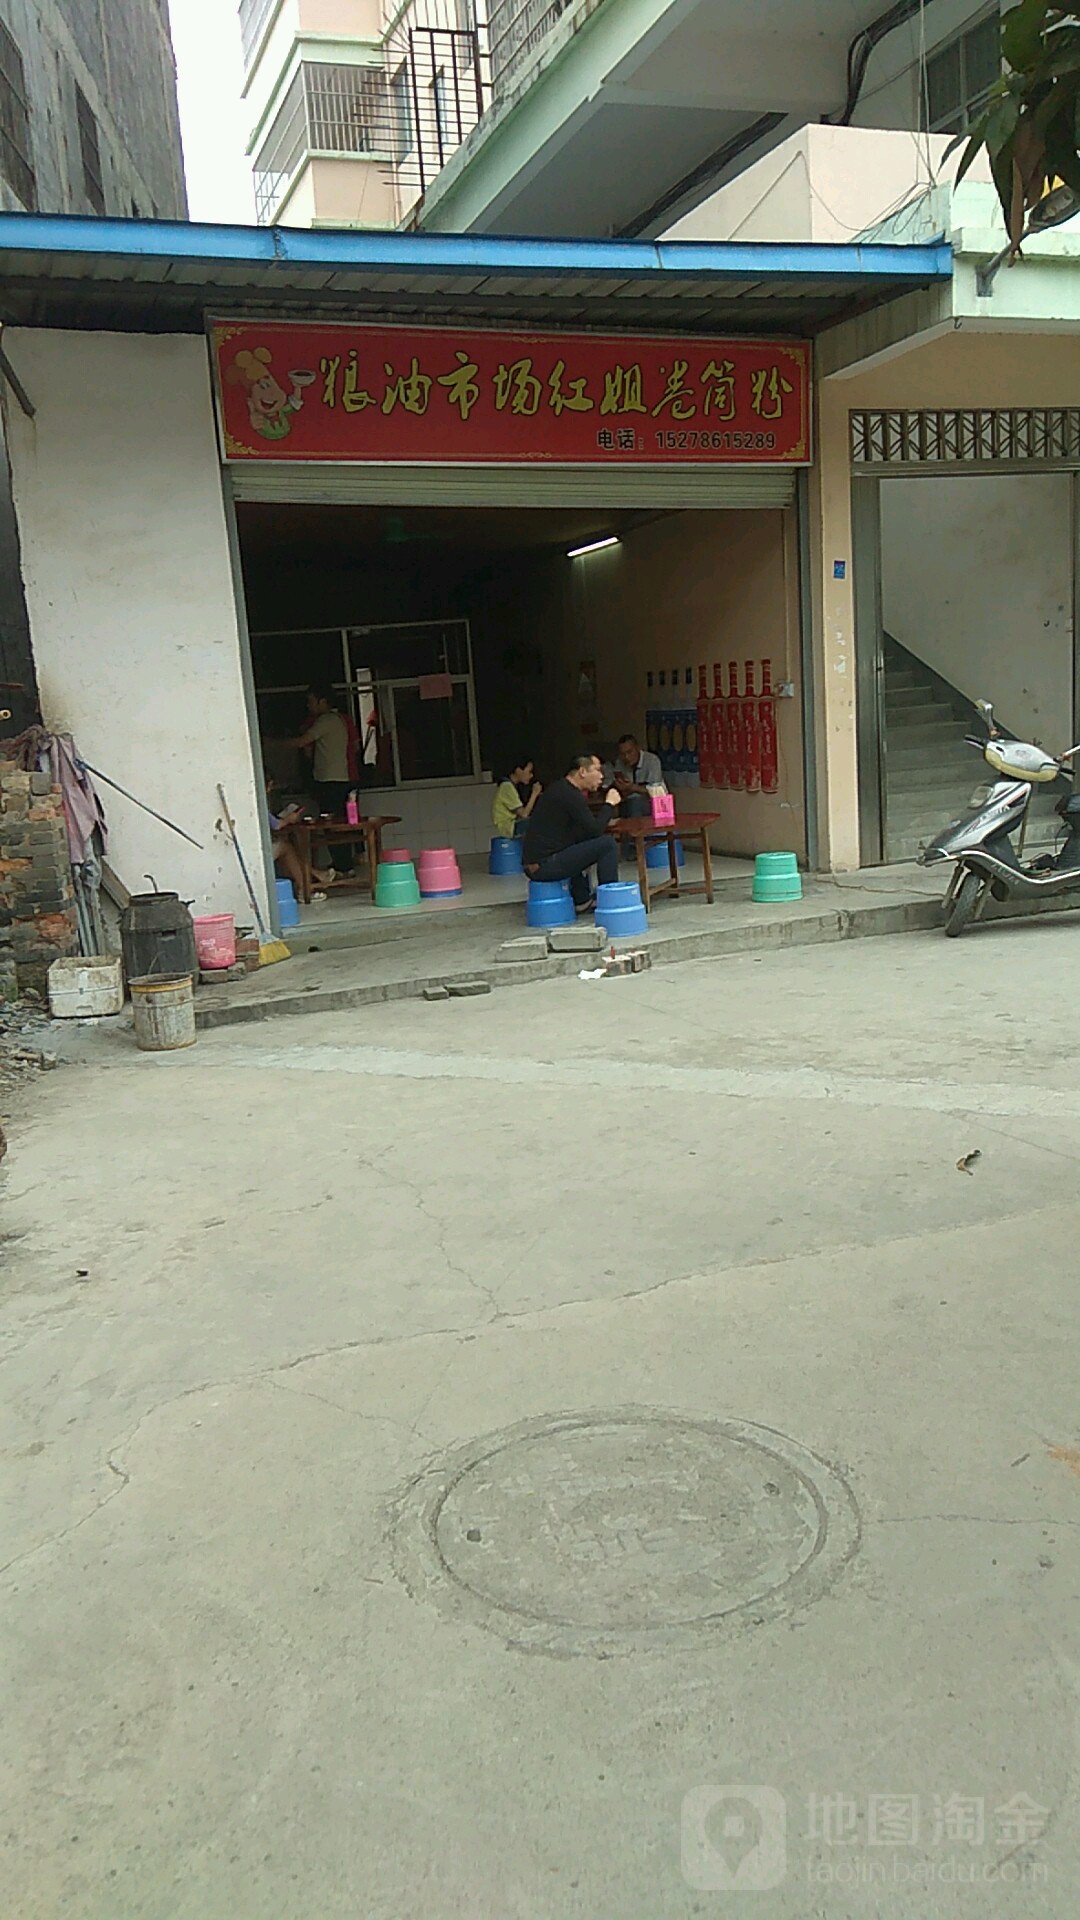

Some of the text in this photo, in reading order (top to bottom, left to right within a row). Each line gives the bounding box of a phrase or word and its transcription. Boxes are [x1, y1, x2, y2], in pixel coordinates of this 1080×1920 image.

[319, 349, 794, 421] 粮油市场红姐卷筒粉
[655, 430, 776, 449] 15278615289
